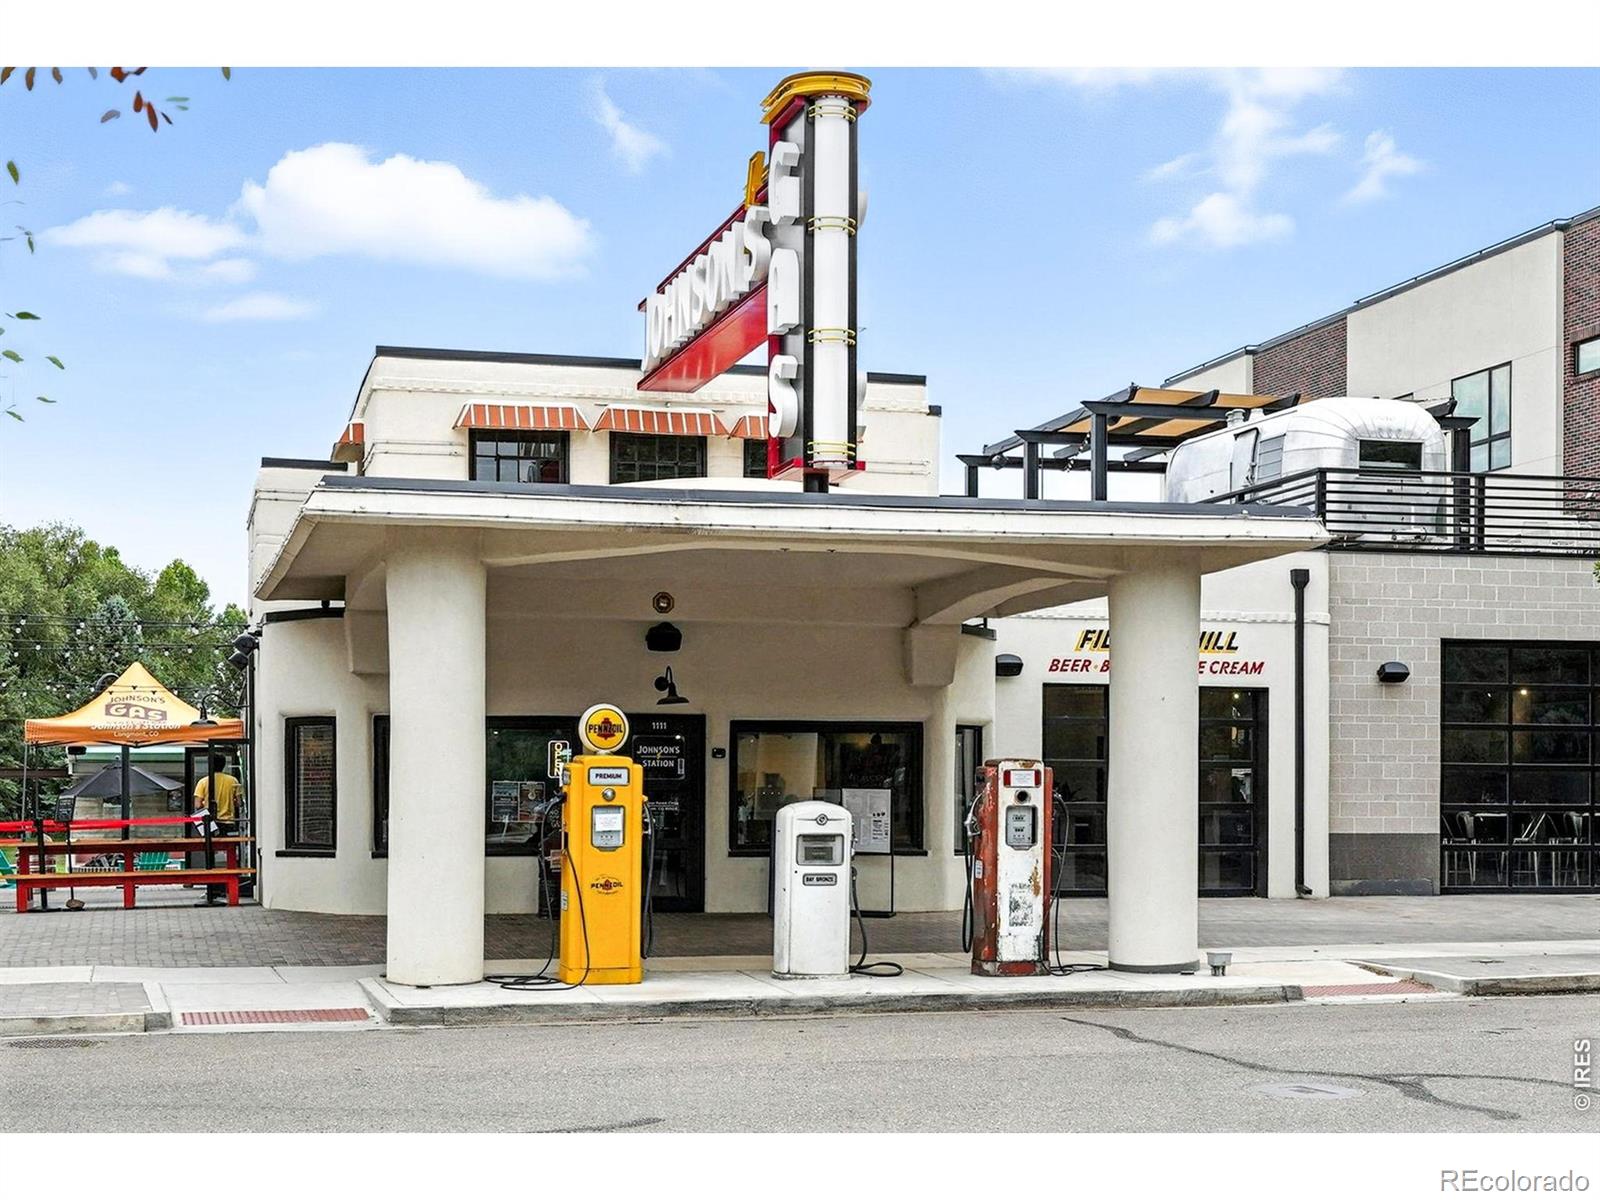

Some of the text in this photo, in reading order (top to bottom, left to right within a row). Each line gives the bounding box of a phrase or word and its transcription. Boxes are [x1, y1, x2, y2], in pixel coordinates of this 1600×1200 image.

[768, 141, 800, 438] GAS
[1049, 658, 1092, 673] BEER
[1209, 661, 1265, 675] CREAM
[110, 695, 166, 704] JOHNSON'S
[109, 703, 163, 721] GAS
[652, 722, 667, 730] 1111
[637, 745, 680, 754] JOHNSON'S
[643, 760, 674, 768] STATION
